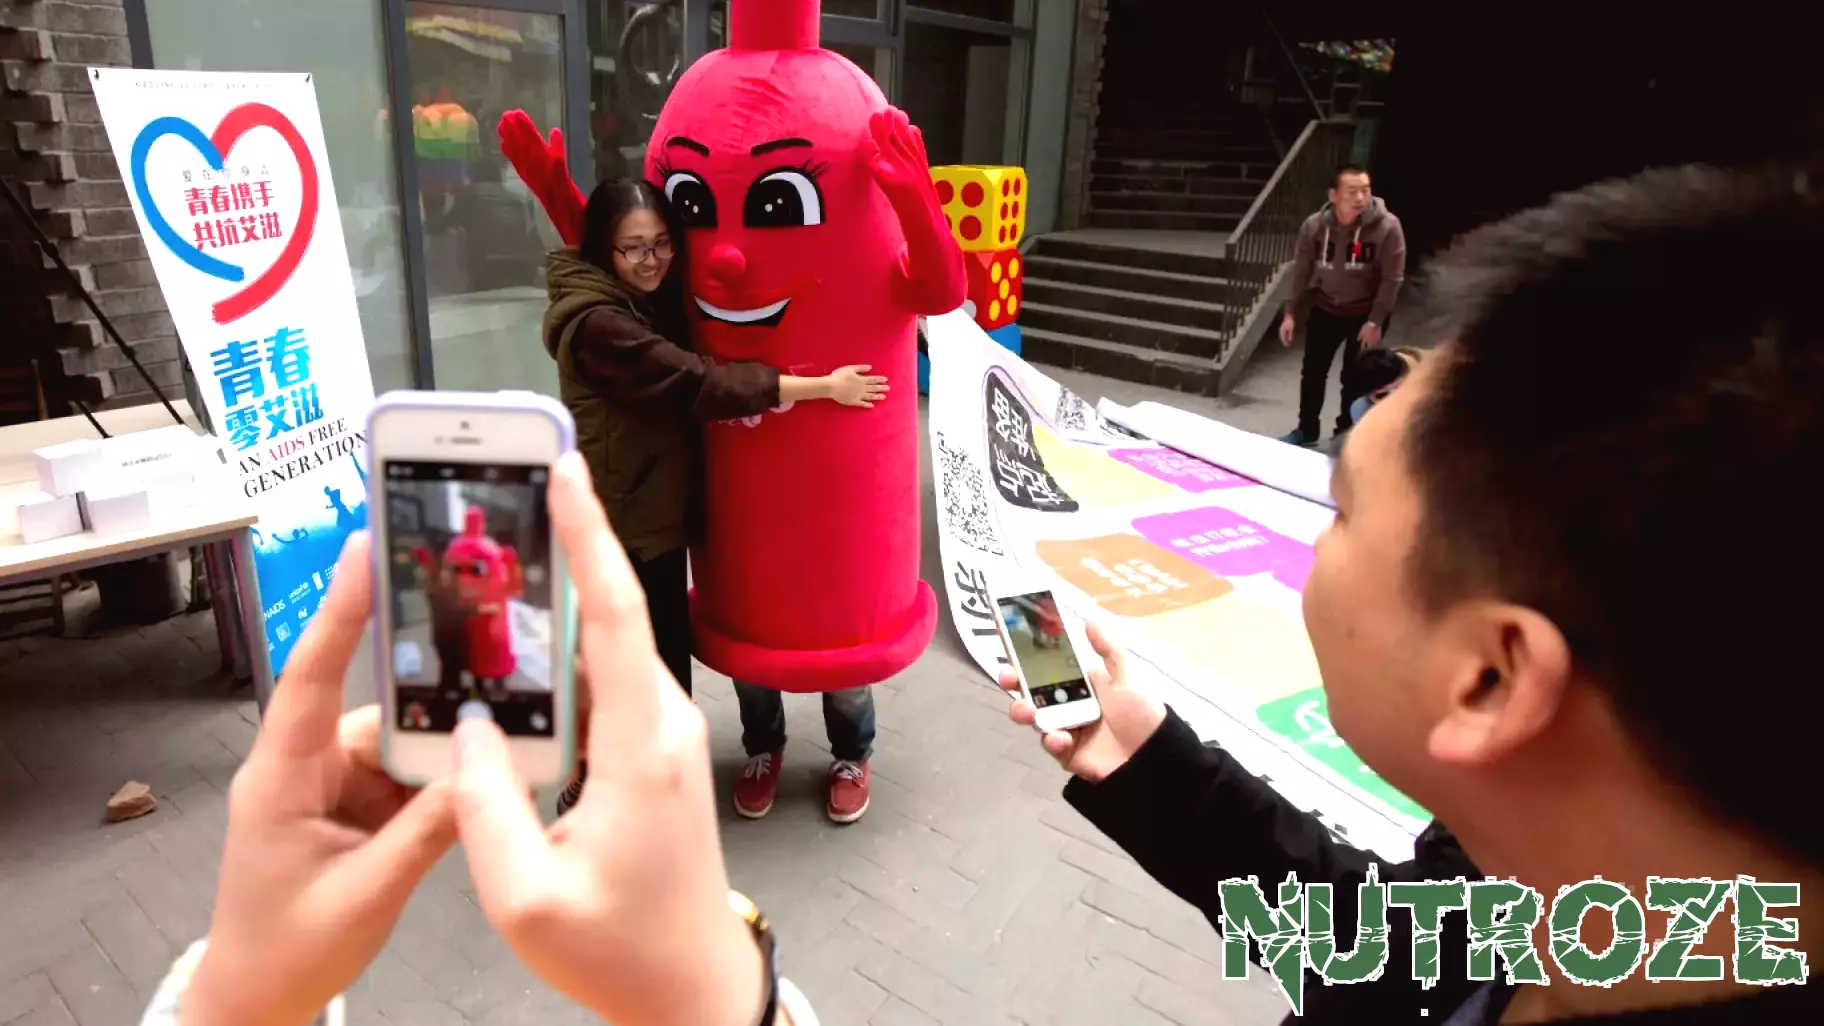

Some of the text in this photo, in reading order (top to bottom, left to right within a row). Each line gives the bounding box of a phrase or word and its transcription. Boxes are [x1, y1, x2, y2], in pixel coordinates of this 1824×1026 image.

[183, 180, 275, 217] 青春携手
[192, 211, 283, 251] 共抗艾滋
[209, 325, 311, 409] 青春
[224, 382, 325, 452] 零艾滋
[239, 417, 348, 476] AN AIDS FREE
[243, 431, 368, 499] GENERATION
